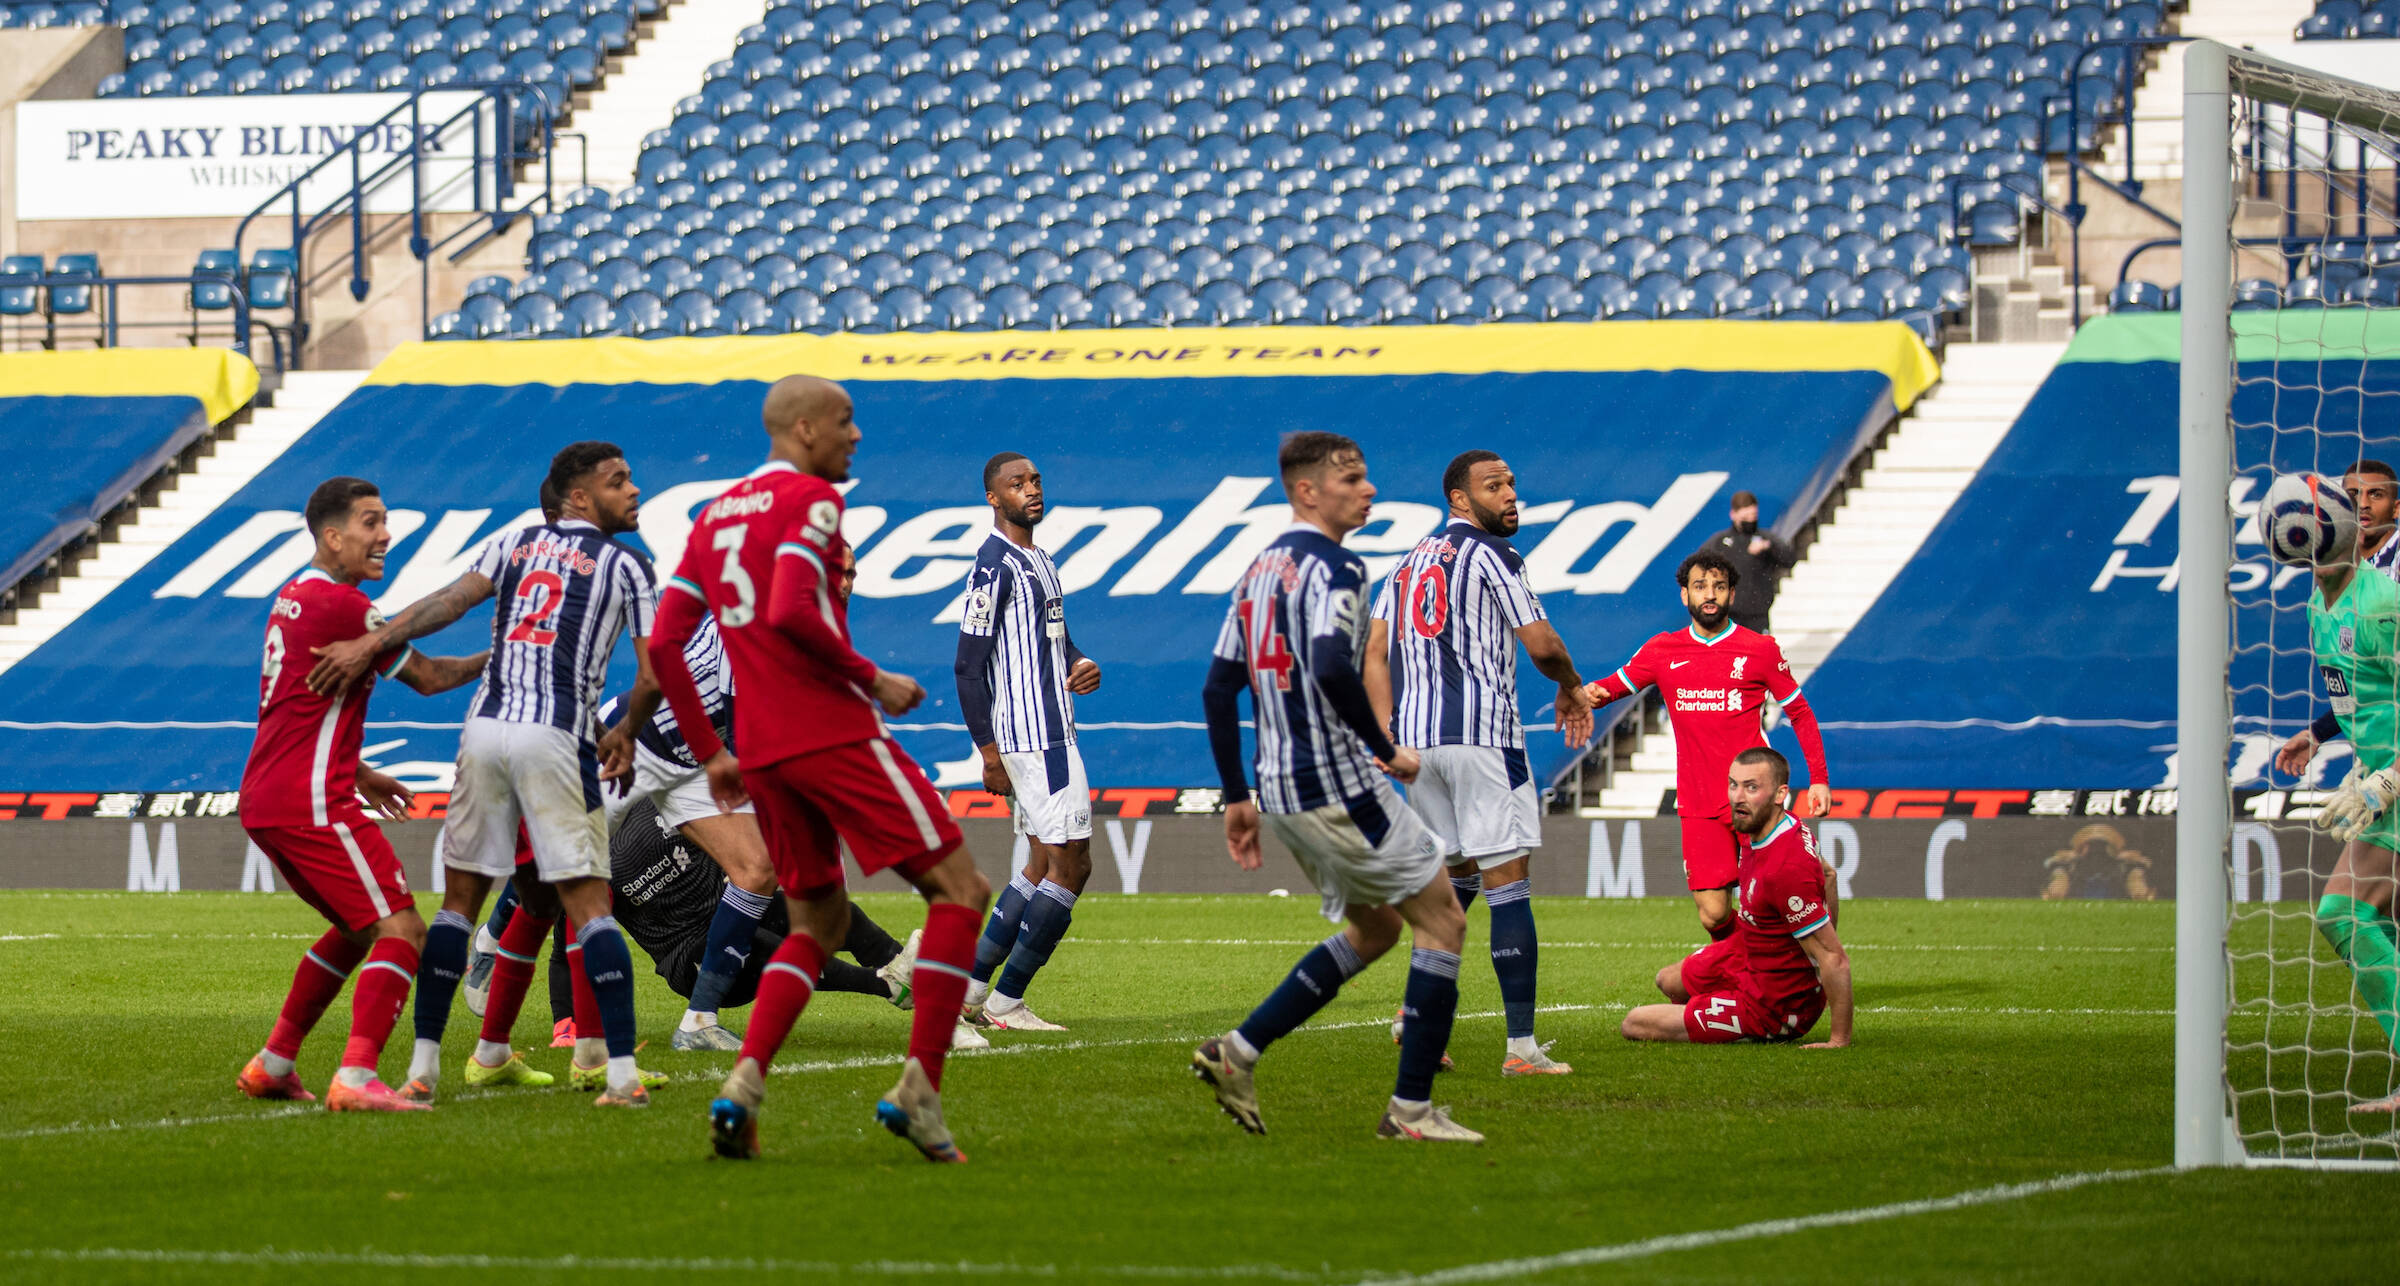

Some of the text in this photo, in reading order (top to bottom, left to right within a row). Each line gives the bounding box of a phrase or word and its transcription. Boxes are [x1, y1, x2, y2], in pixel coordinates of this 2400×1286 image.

[67, 127, 222, 160] PEAKY
[861, 344, 1383, 367] WE ARE ONE TEAM
[511, 540, 597, 576] FURLONG
[712, 523, 757, 628] 3
[505, 570, 563, 646] 2
[1395, 564, 1448, 643] 10
[1239, 594, 1294, 694] 14
[263, 624, 286, 708] 9
[2324, 670, 2347, 694] deal
[1675, 700, 1725, 712] Chartered
[1676, 688, 1725, 699] Standard
[622, 855, 672, 897] Standard
[630, 865, 681, 907] Chartered
[1492, 946, 1521, 959] WBA
[594, 969, 625, 984] WBA
[1704, 997, 1743, 1035] 47
